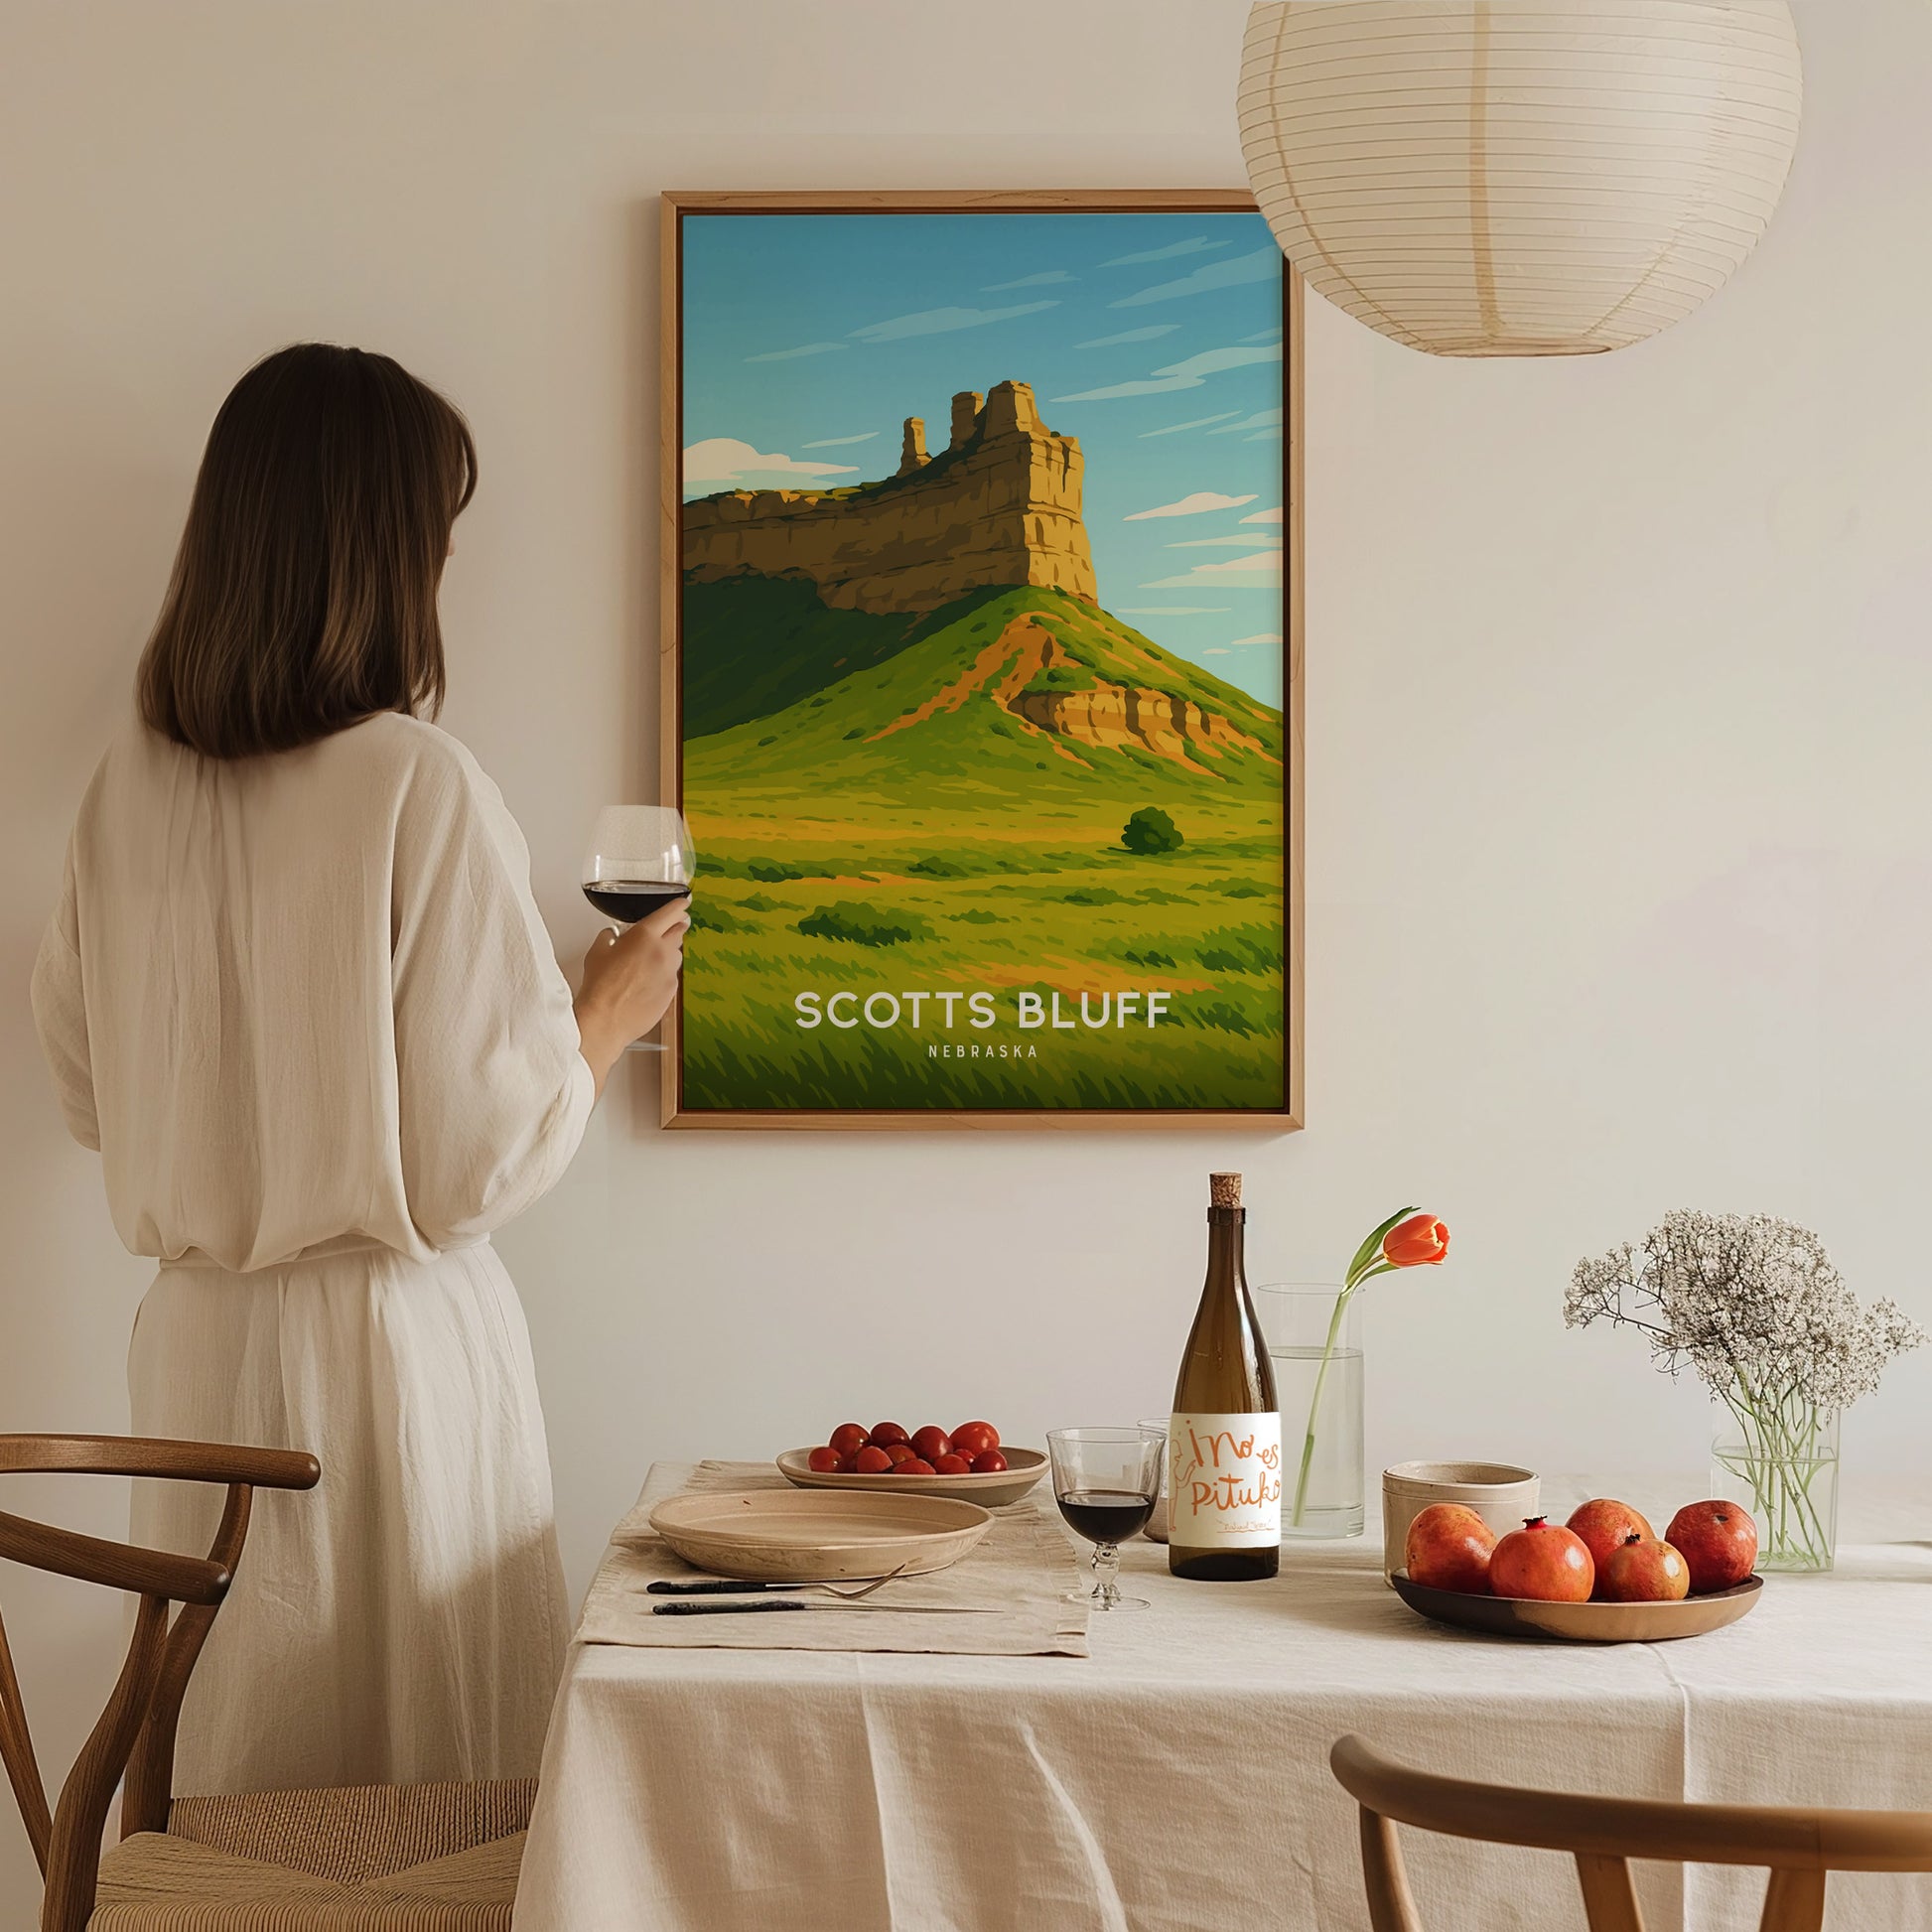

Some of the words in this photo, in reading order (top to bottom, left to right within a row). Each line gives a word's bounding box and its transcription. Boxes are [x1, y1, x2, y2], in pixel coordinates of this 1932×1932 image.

[794, 991, 996, 1029] SCOTTS
[1019, 991, 1172, 1029] BLUFF
[927, 1044, 1038, 1059] NEBRASKA
[1256, 1444, 1279, 1470] es
